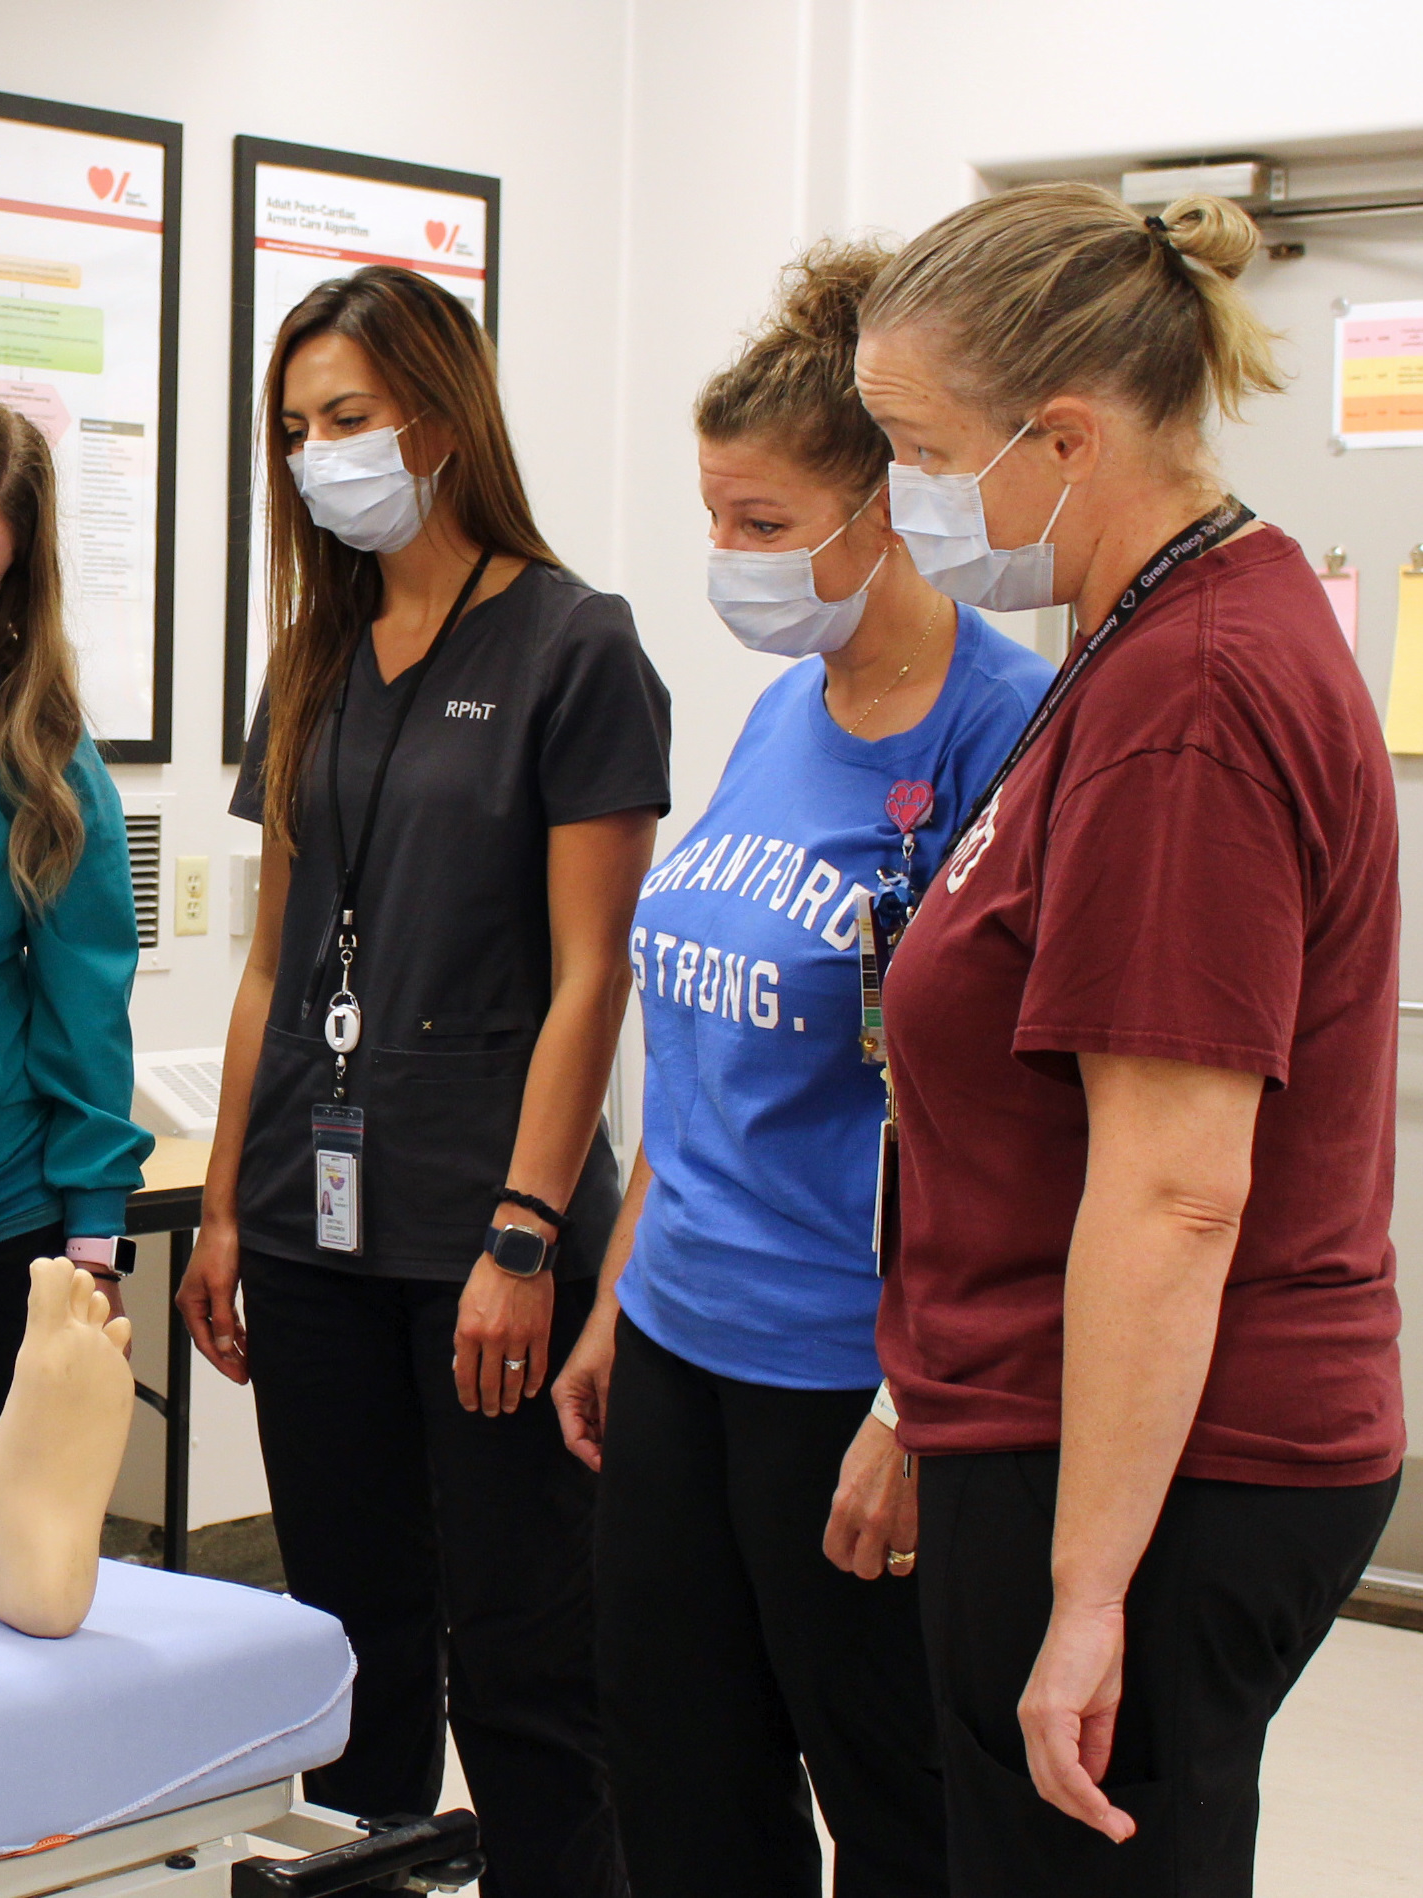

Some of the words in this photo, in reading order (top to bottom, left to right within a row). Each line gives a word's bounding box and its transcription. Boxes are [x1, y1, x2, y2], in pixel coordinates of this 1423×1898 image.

[266, 196, 292, 211] Adult
[267, 212, 297, 227] Arrest
[299, 216, 321, 230] Care
[324, 221, 369, 238] Algorithm
[1140, 557, 1174, 589] Great
[1169, 533, 1203, 560] Place
[1087, 613, 1119, 652] Wisely
[444, 700, 497, 721] RPhT
[630, 926, 807, 1032] STRONG.
